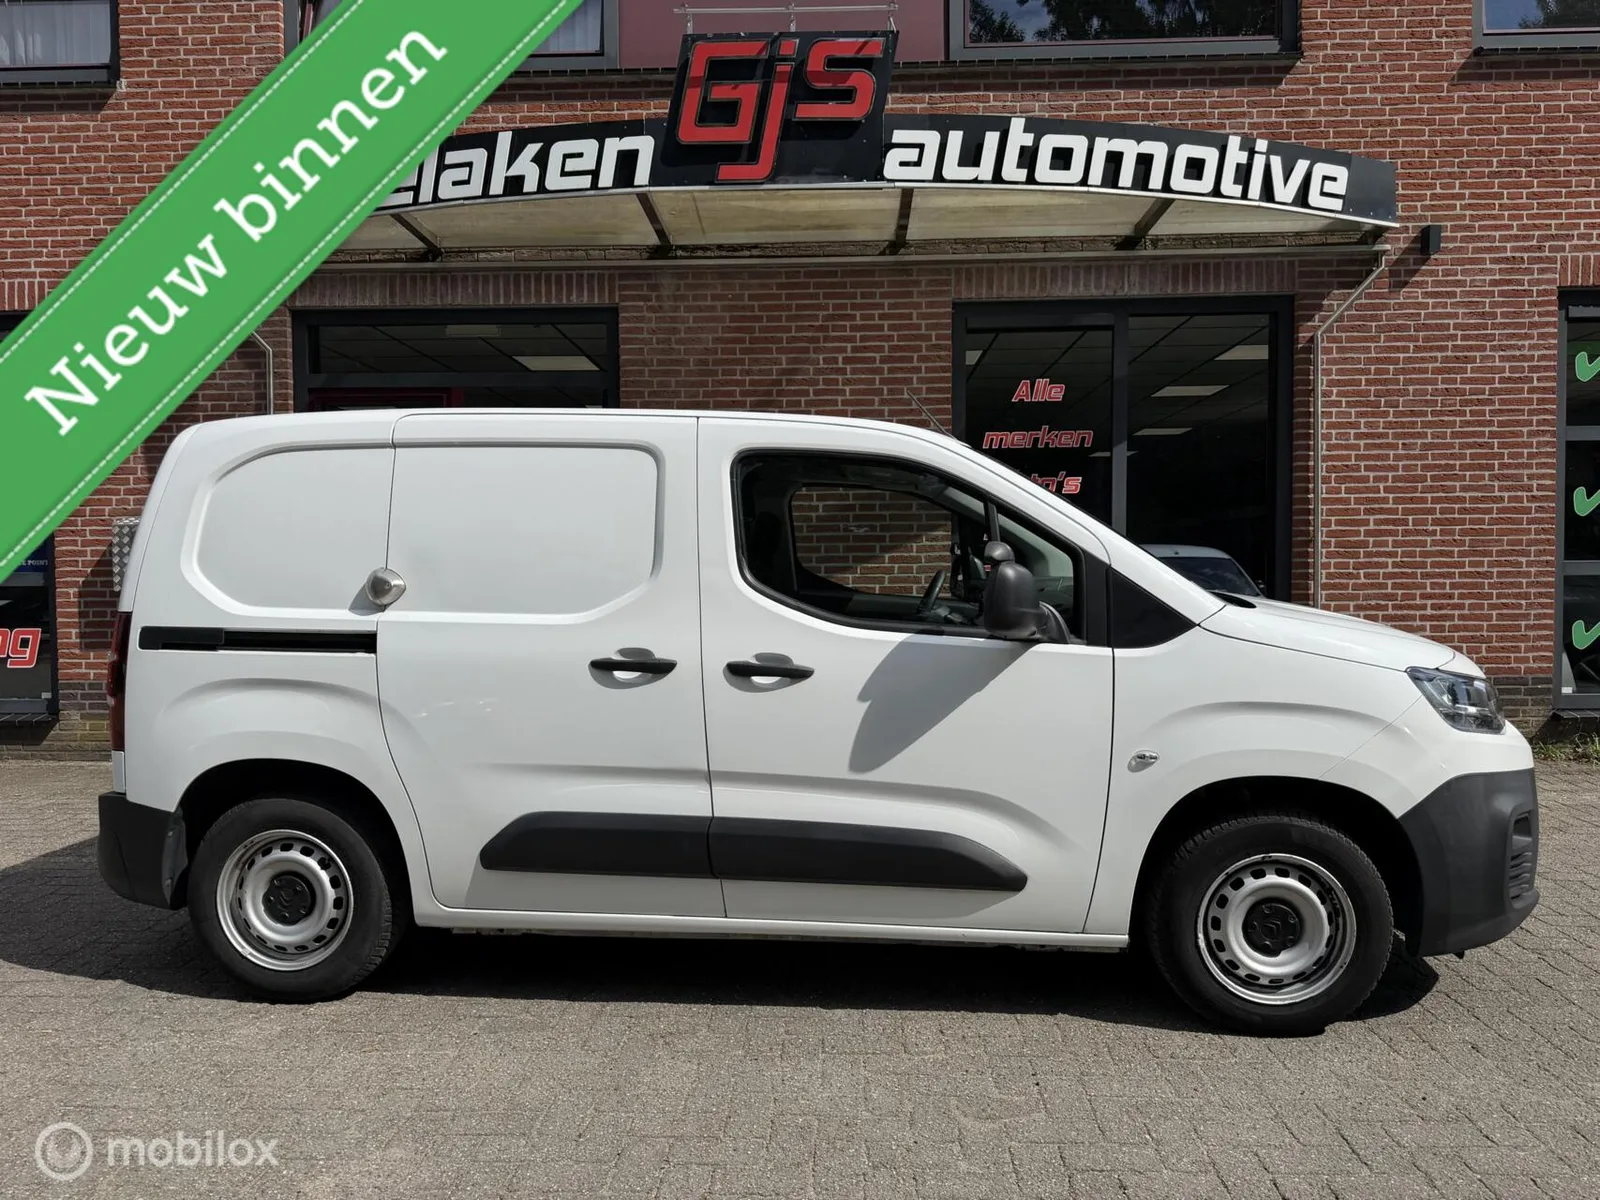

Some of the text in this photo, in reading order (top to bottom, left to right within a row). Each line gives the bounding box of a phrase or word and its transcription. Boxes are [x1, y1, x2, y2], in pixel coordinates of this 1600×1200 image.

[882, 117, 1349, 211] automotive
[1012, 378, 1065, 402] Alle
[982, 425, 1094, 449] merken
